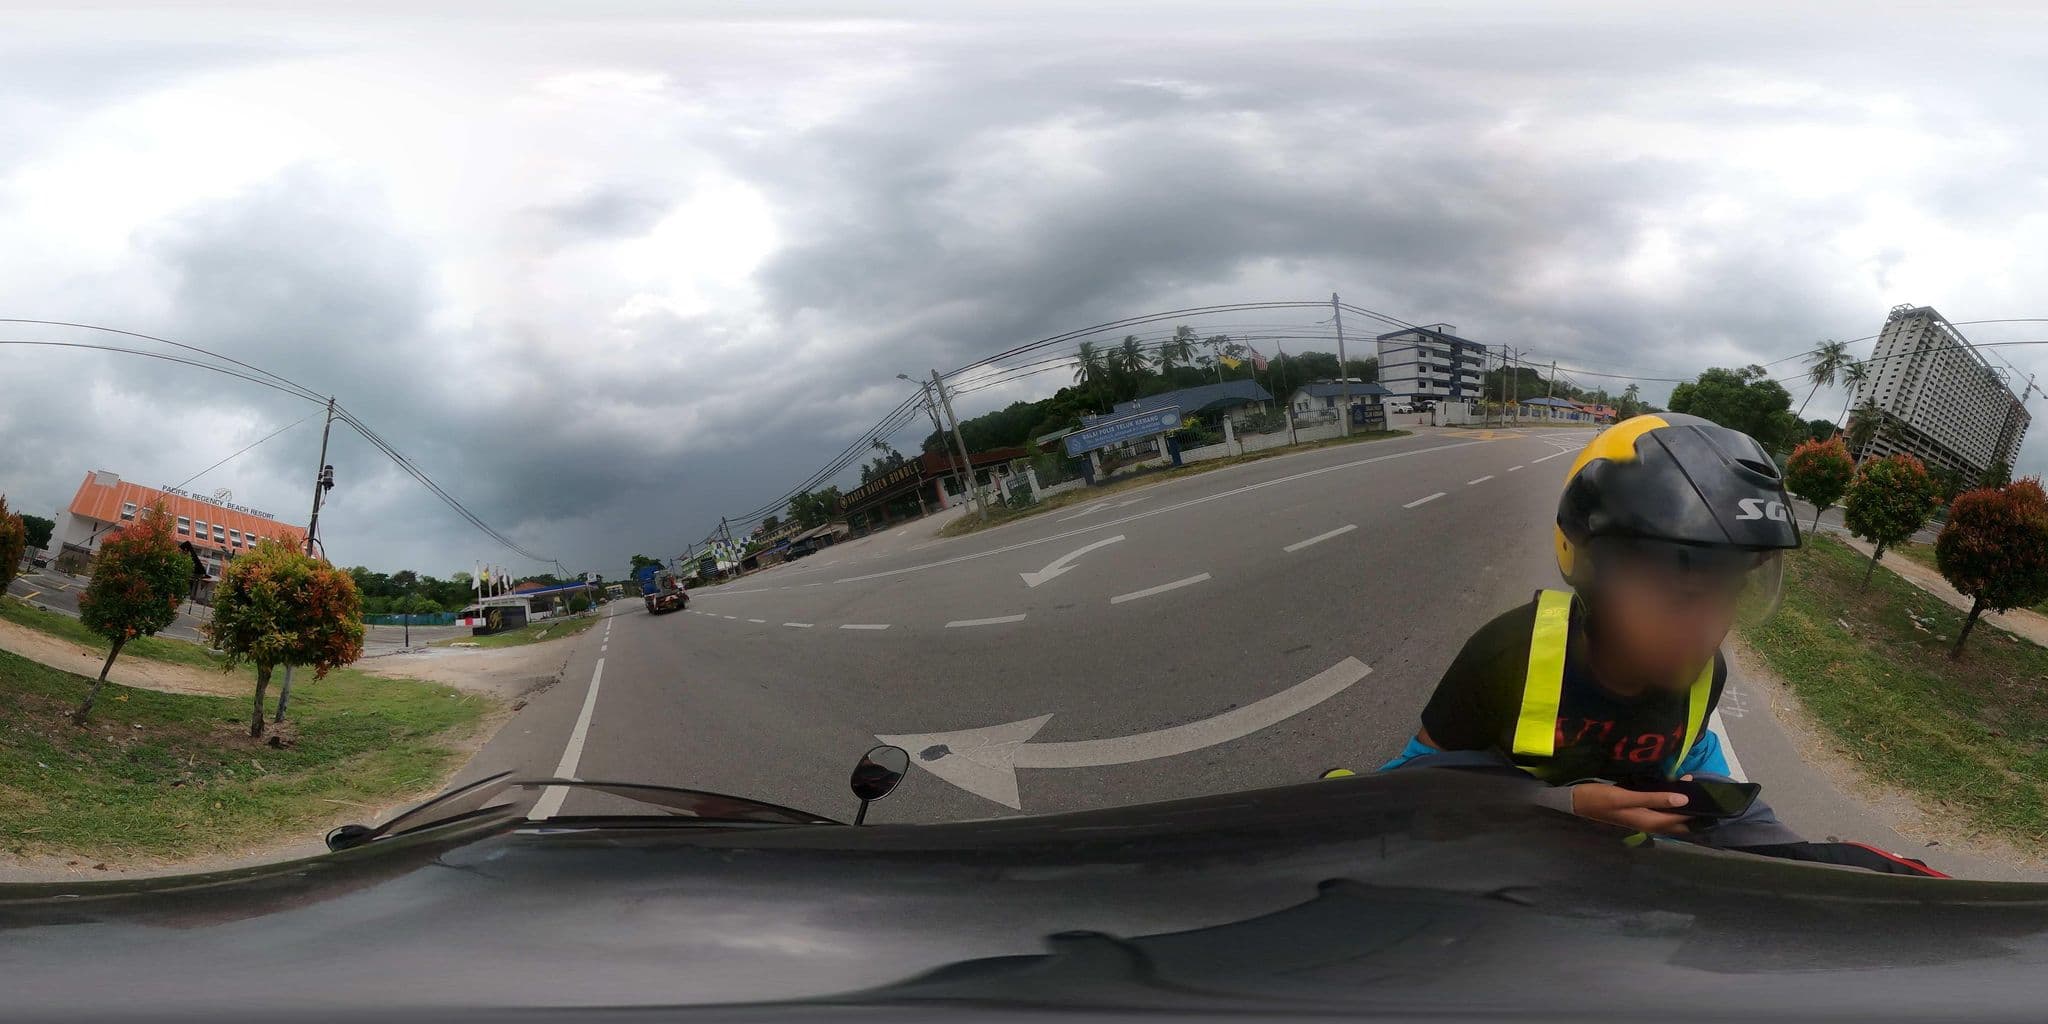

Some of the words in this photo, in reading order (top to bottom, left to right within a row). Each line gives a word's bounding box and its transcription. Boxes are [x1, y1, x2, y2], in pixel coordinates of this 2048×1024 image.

[1100, 426, 1115, 437] POLIS
[162, 485, 188, 497] PACIFIC
[192, 493, 224, 506] REGENCY
[227, 502, 248, 513] BEACH
[250, 509, 275, 520] RESORT
